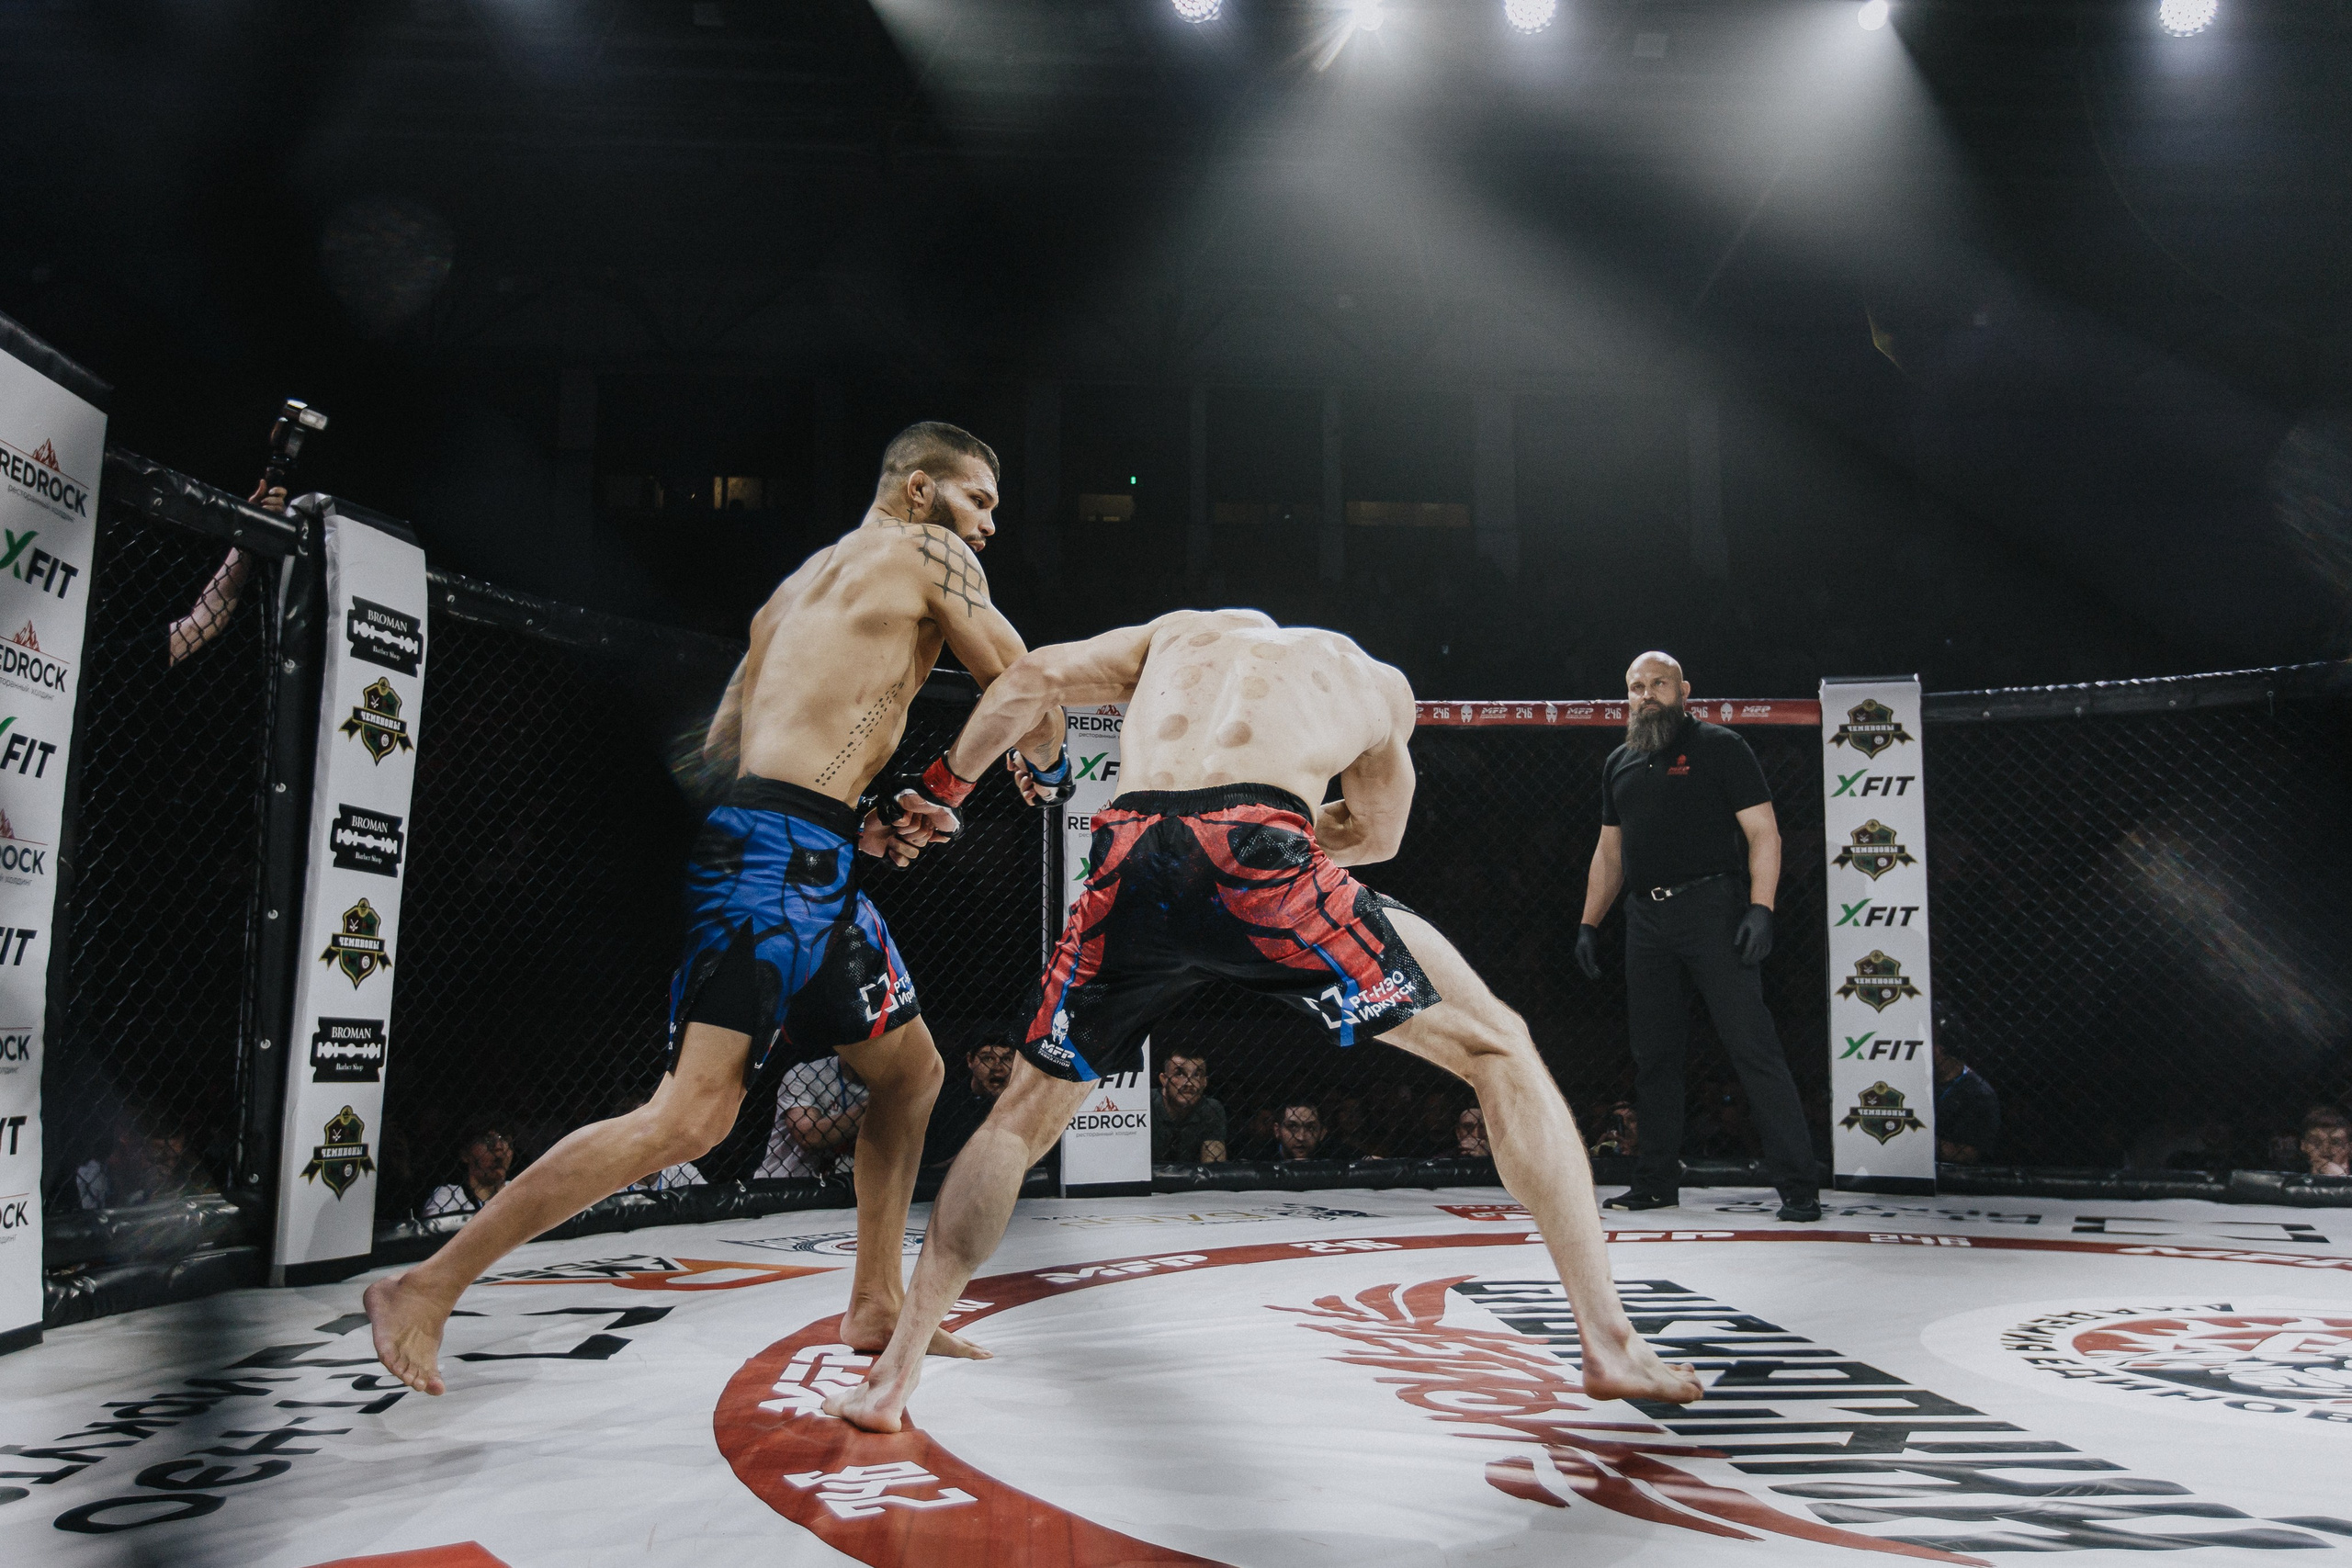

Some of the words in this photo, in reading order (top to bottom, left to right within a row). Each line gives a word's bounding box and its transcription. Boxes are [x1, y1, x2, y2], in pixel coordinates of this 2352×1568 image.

[0, 447, 87, 518] REDROCK
[368, 609, 408, 632] BROMAN
[0, 644, 68, 693] DROCK
[360, 710, 401, 731] ЧЕМПИОНЫ
[1068, 716, 1124, 732] REDRO
[1074, 752, 1121, 782] XF
[352, 815, 388, 833] BROMAN
[339, 936, 379, 950] ЧЕМПИОНЫ
[1359, 981, 1416, 1021] Иркутск
[332, 1026, 372, 1039] BROMAN
[1041, 1039, 1075, 1059] MFP
[1098, 1071, 1143, 1089] FIT
[1066, 1113, 1148, 1130] REDROCK
[322, 1146, 363, 1157] ЧЕМПИОНЫ
[1035, 1254, 1208, 1284] MFP
